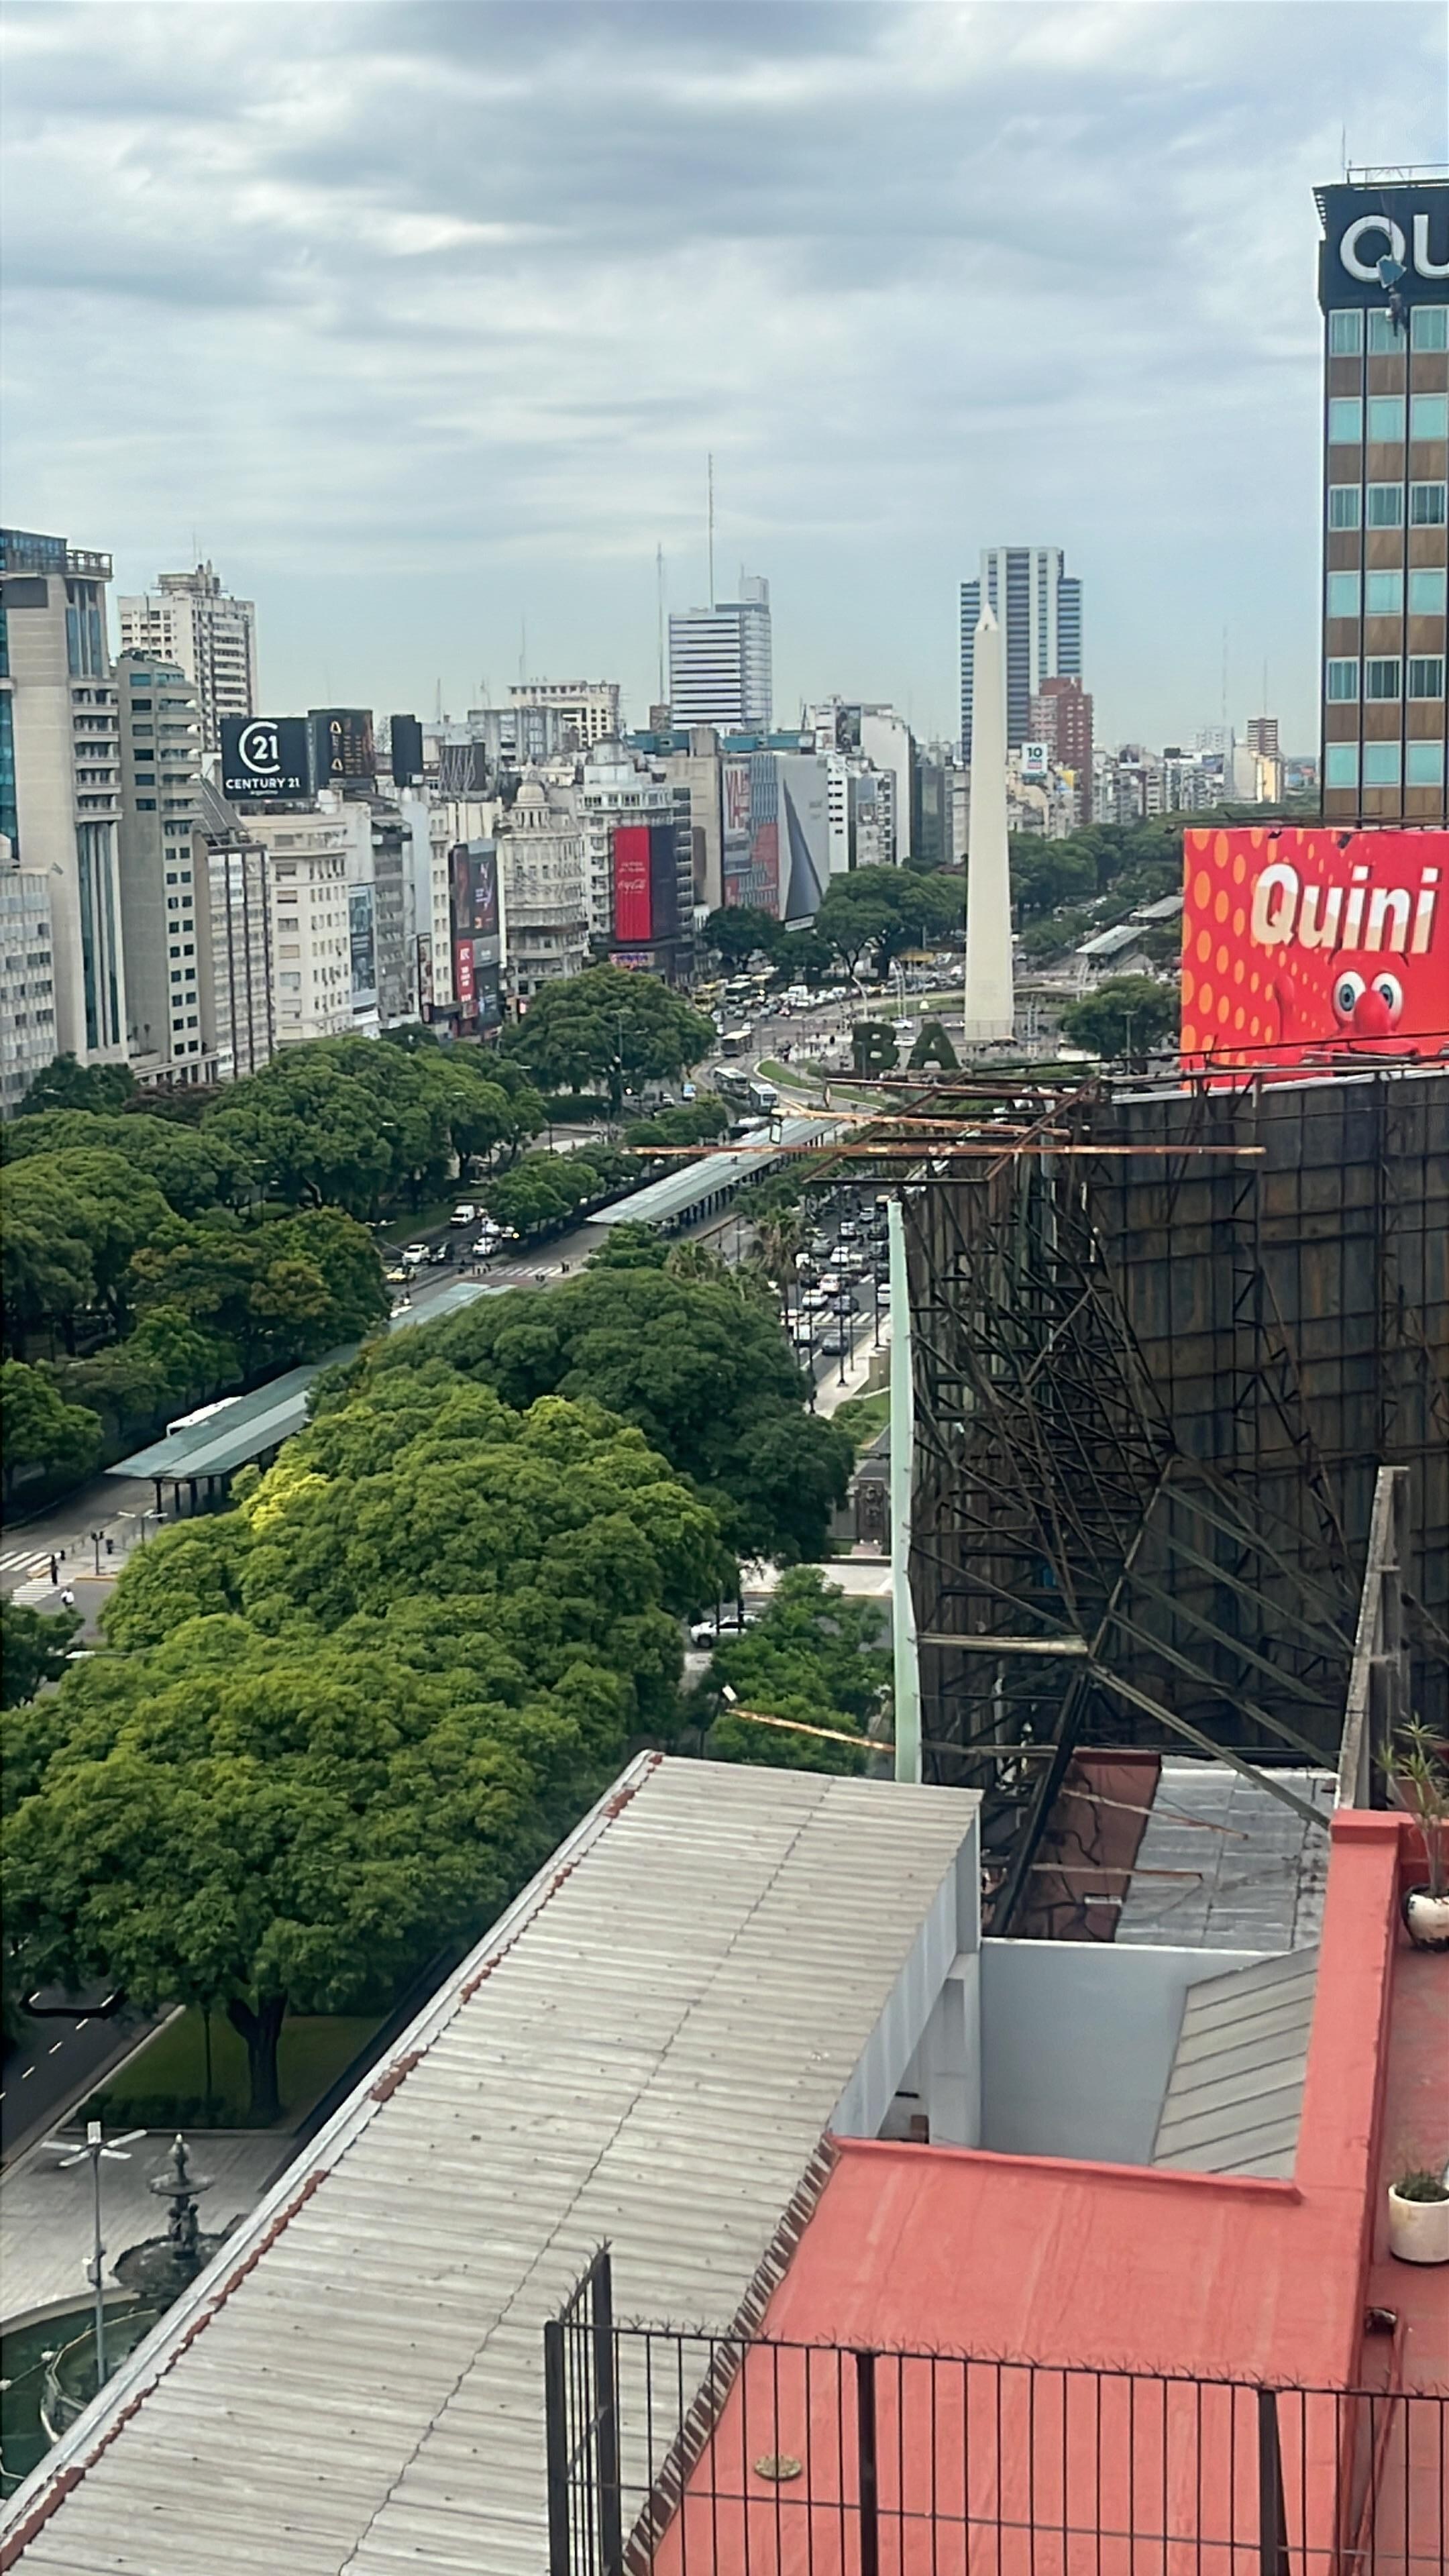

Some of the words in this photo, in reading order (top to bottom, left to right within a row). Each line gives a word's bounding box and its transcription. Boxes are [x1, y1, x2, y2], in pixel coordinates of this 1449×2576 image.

[1340, 214, 1449, 282] QU
[1026, 747, 1042, 758] 10
[225, 777, 286, 789] CENTURY
[288, 777, 301, 788] 21
[1250, 862, 1441, 954] Quini
